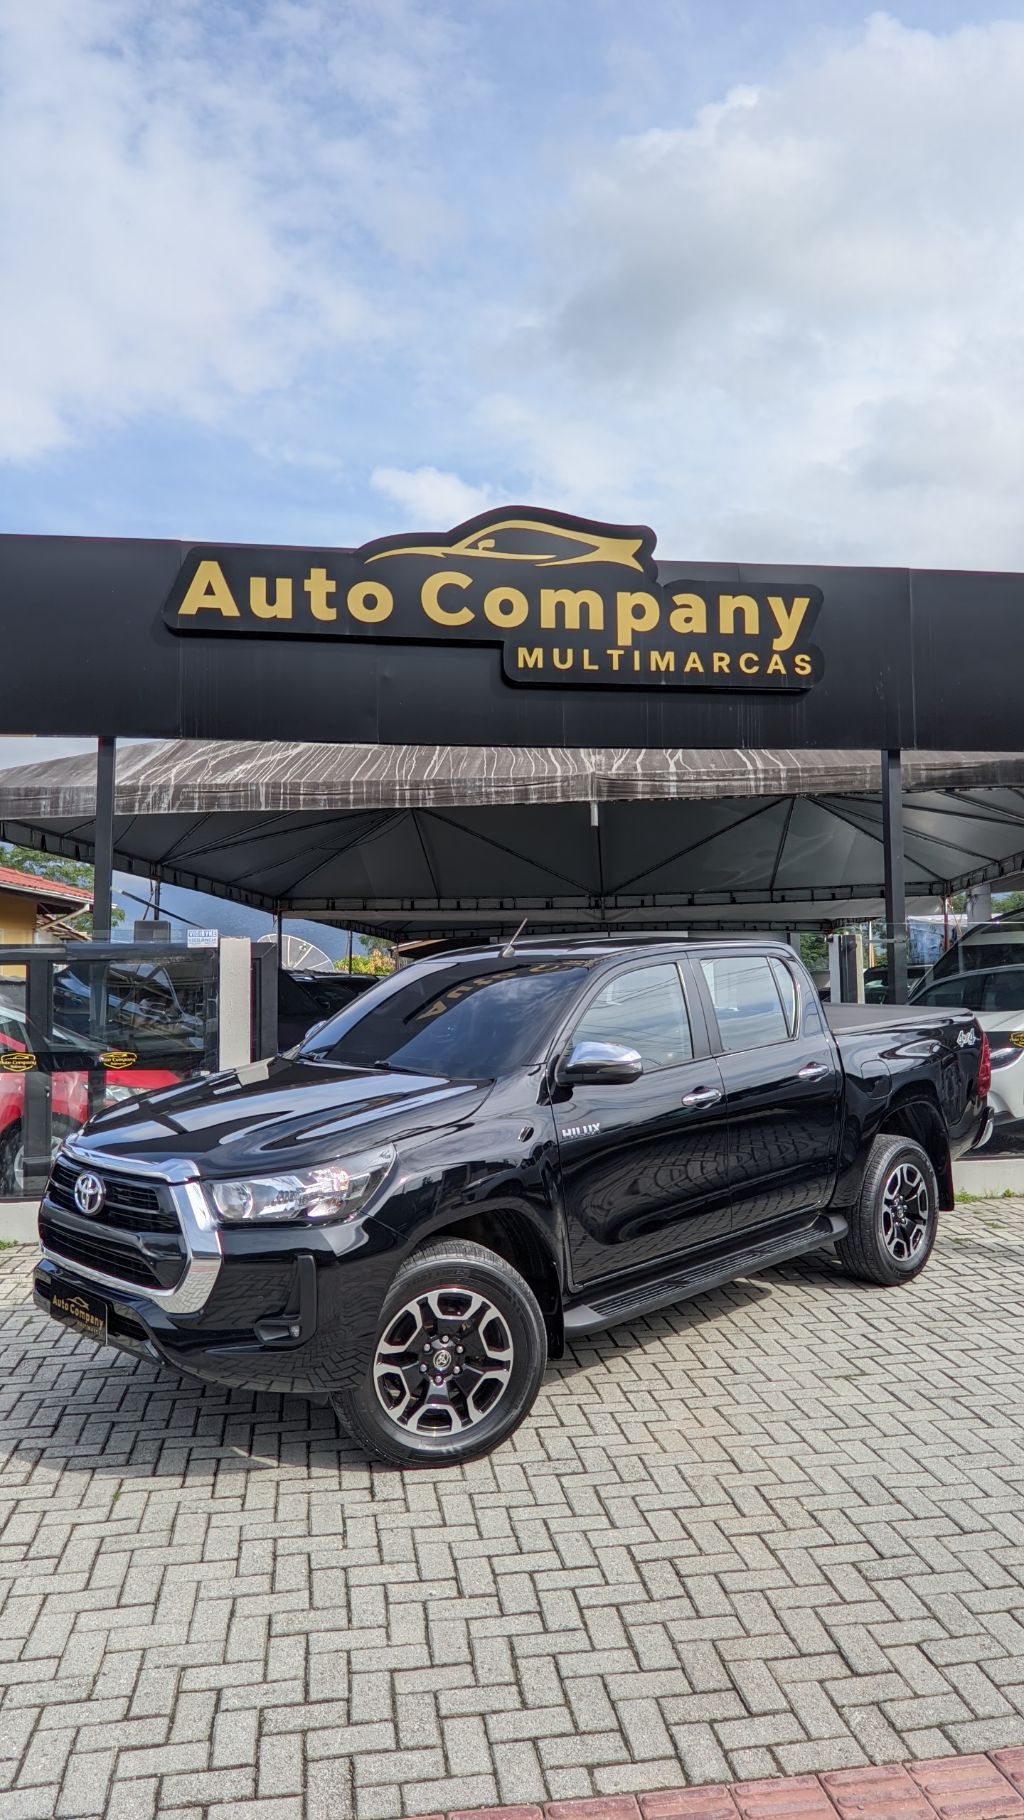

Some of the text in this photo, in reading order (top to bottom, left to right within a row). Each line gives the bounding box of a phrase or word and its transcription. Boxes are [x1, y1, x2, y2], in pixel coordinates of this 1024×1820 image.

[178, 560, 809, 652] Auto Company
[517, 646, 812, 676] MULTIMARCAS
[957, 1028, 976, 1048] 4x4
[562, 1122, 600, 1138] HILUX
[53, 1295, 69, 1310] Auto
[70, 1303, 104, 1331] Company
